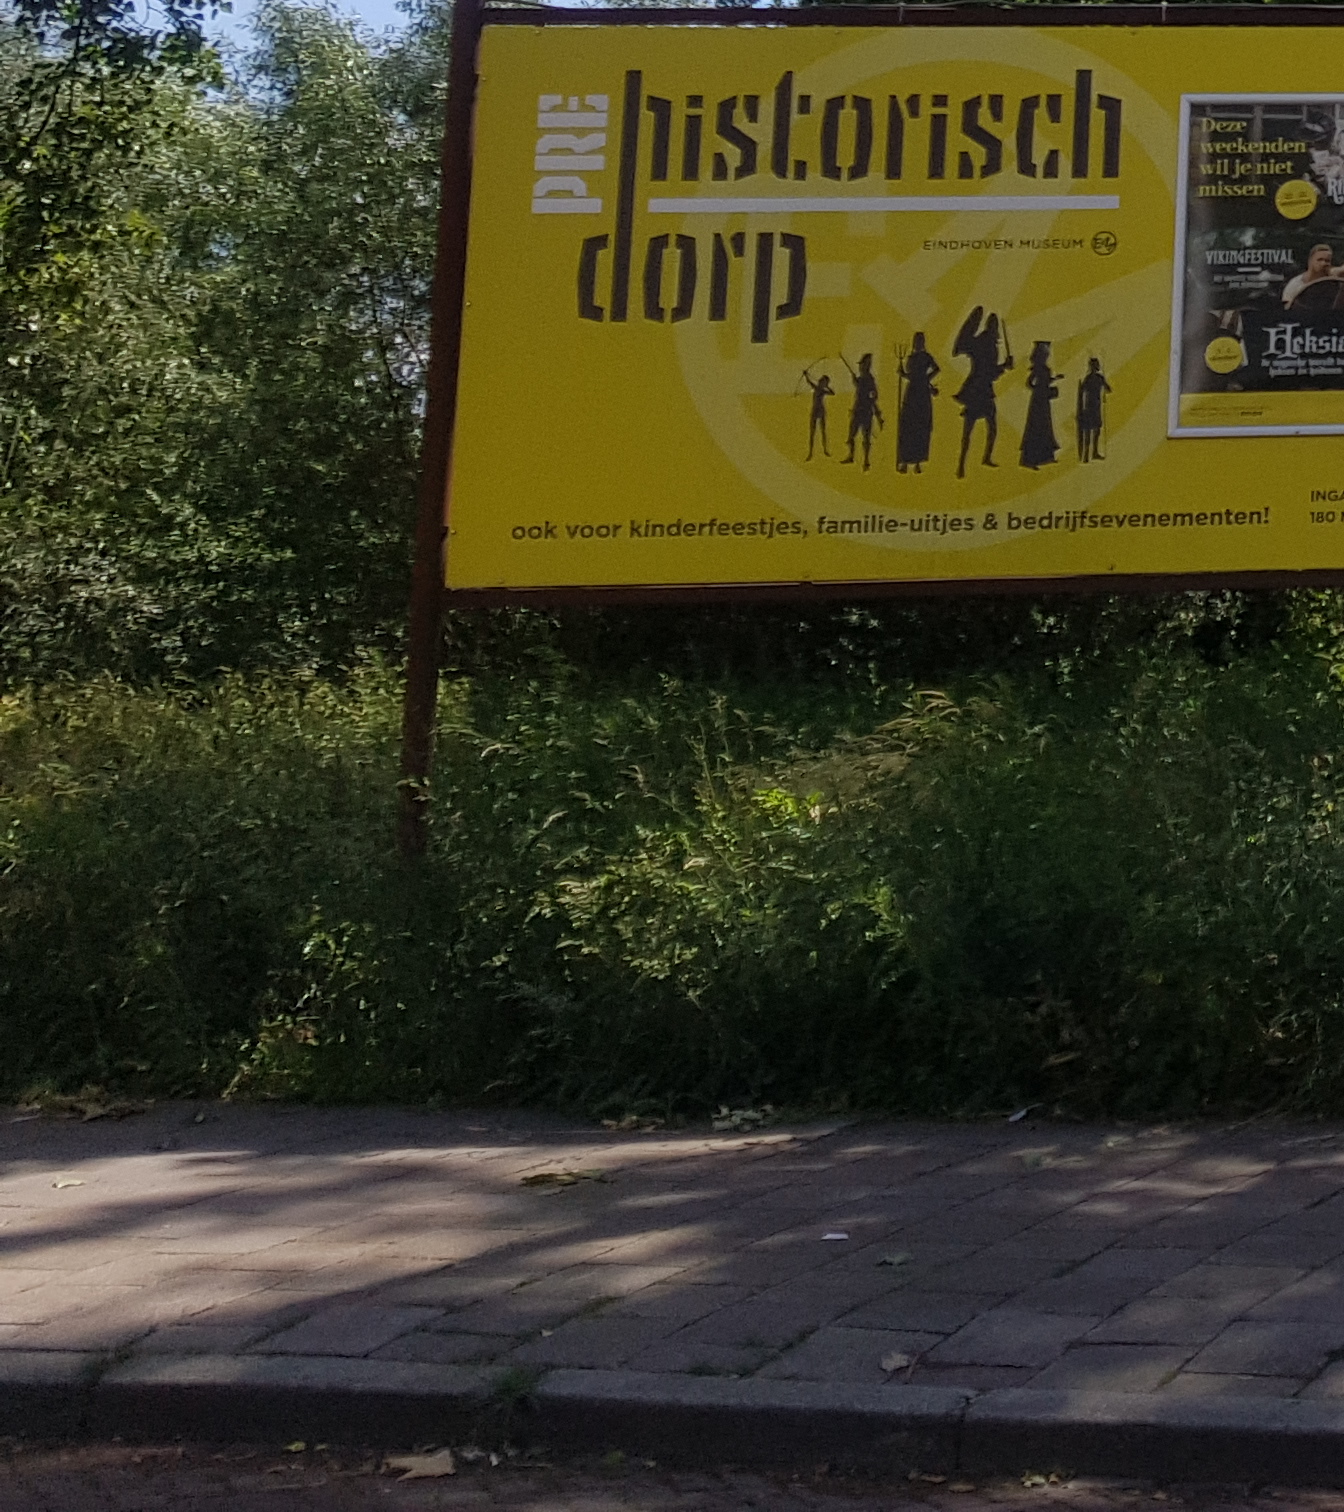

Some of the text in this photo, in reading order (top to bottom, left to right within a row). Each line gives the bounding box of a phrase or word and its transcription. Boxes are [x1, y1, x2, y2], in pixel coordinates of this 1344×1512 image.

[616, 68, 1122, 181] historisch
[1201, 117, 1247, 133] Deze
[531, 93, 608, 213] PRE
[1200, 137, 1307, 154] weekenden
[1199, 159, 1294, 178] wil je niet
[1197, 181, 1267, 198] missen
[922, 239, 1014, 251] EINDHOVEN
[1019, 238, 1084, 250] MUSEUM
[1205, 248, 1295, 266] VIKINGFESTIVAL
[577, 232, 807, 343] dorp
[511, 506, 1270, 539] ook voor kinderfeestjes, familie-uitjes & bedrijfsevenementen!
[1309, 510, 1336, 524] 180
